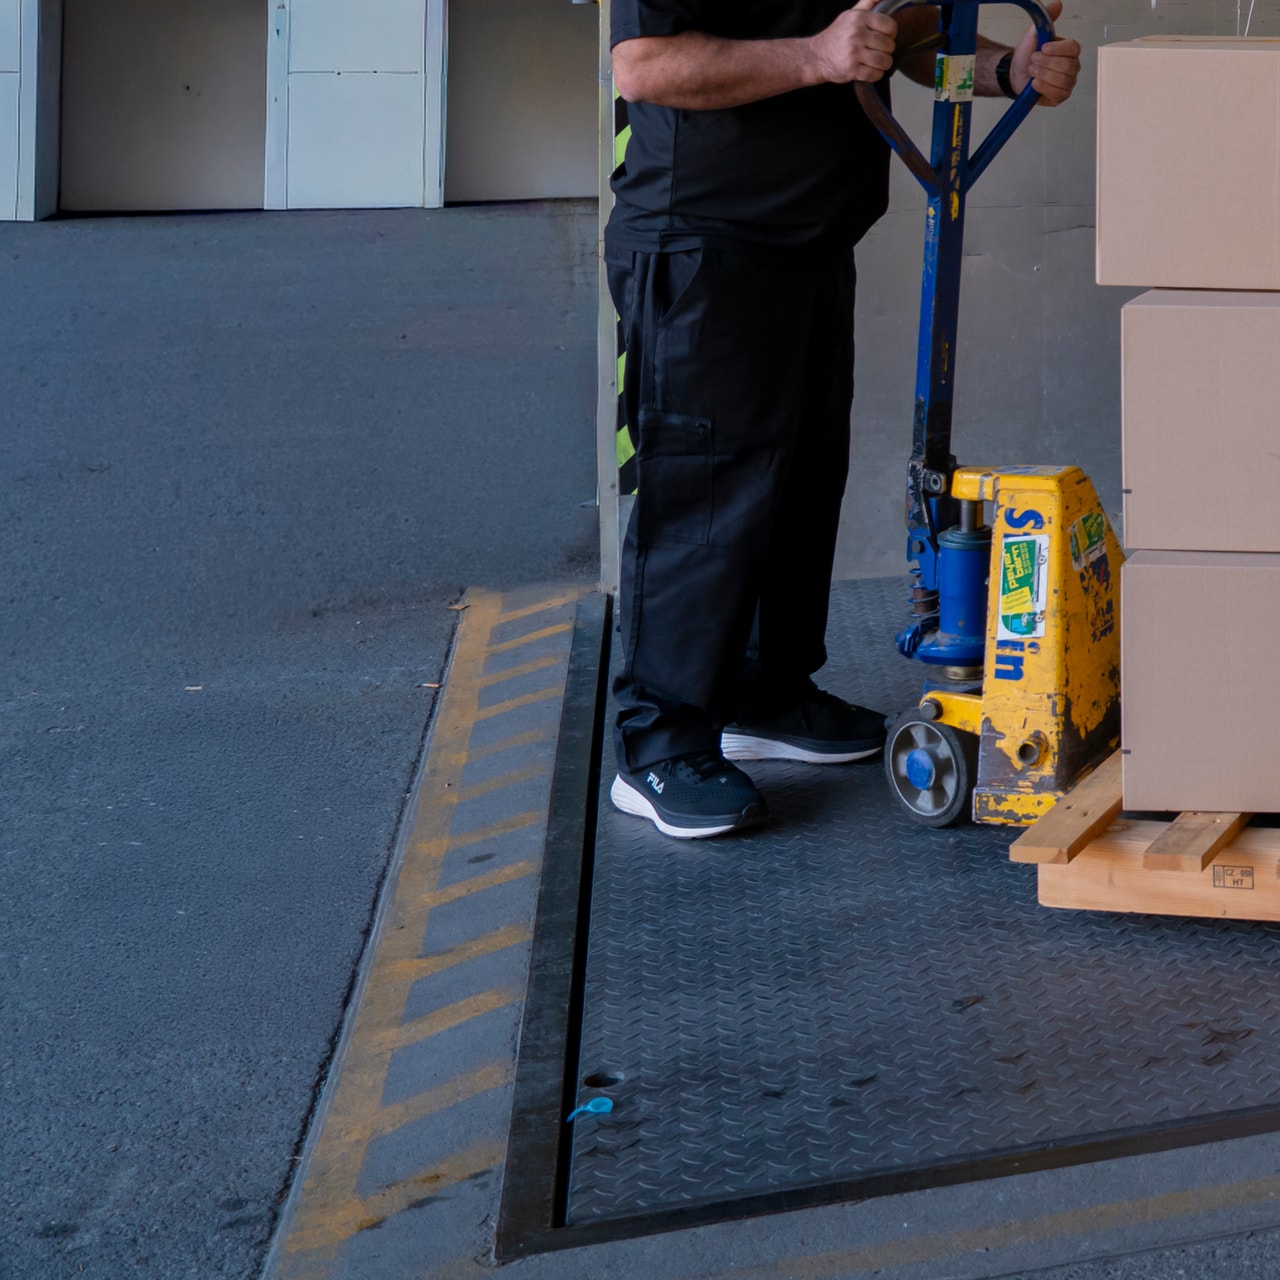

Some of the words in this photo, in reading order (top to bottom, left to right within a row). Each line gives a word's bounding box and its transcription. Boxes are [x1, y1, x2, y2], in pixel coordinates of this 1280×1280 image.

[646, 771, 665, 795] FILA
[1225, 868, 1235, 877] CZ
[1232, 878, 1244, 886] HT
